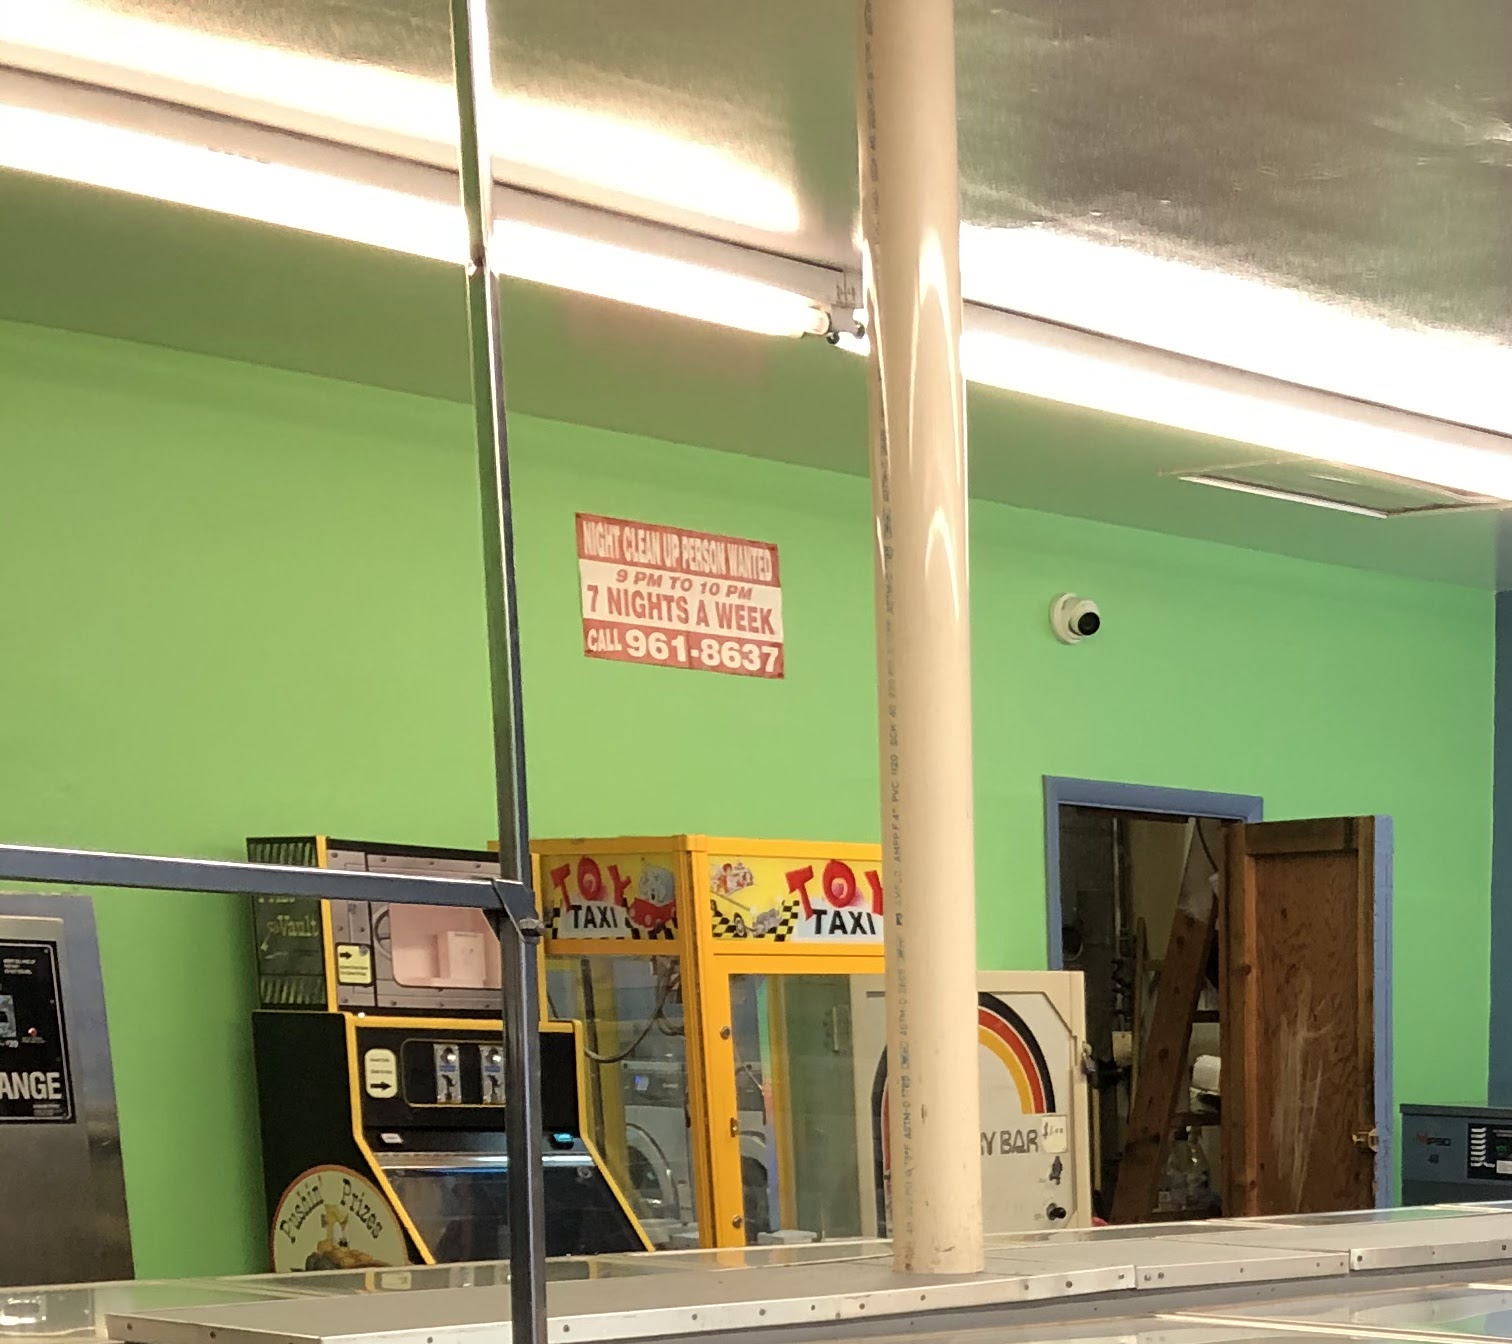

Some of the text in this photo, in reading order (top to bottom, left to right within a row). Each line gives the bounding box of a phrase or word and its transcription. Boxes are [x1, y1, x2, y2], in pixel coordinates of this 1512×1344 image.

[583, 520, 773, 582] NIGHT CLEAN UP PERSON WANTED
[616, 569, 753, 600] 9 PM TO 10 PM
[587, 584, 775, 635] 7 NIGHTS A WEEK
[587, 628, 779, 673] CALL 961-8637
[551, 856, 631, 913] TOY
[570, 904, 618, 930] TAXI
[812, 909, 876, 935] TAXI
[1000, 1129, 1039, 1155] BAR
[340, 1178, 383, 1239] Prizes
